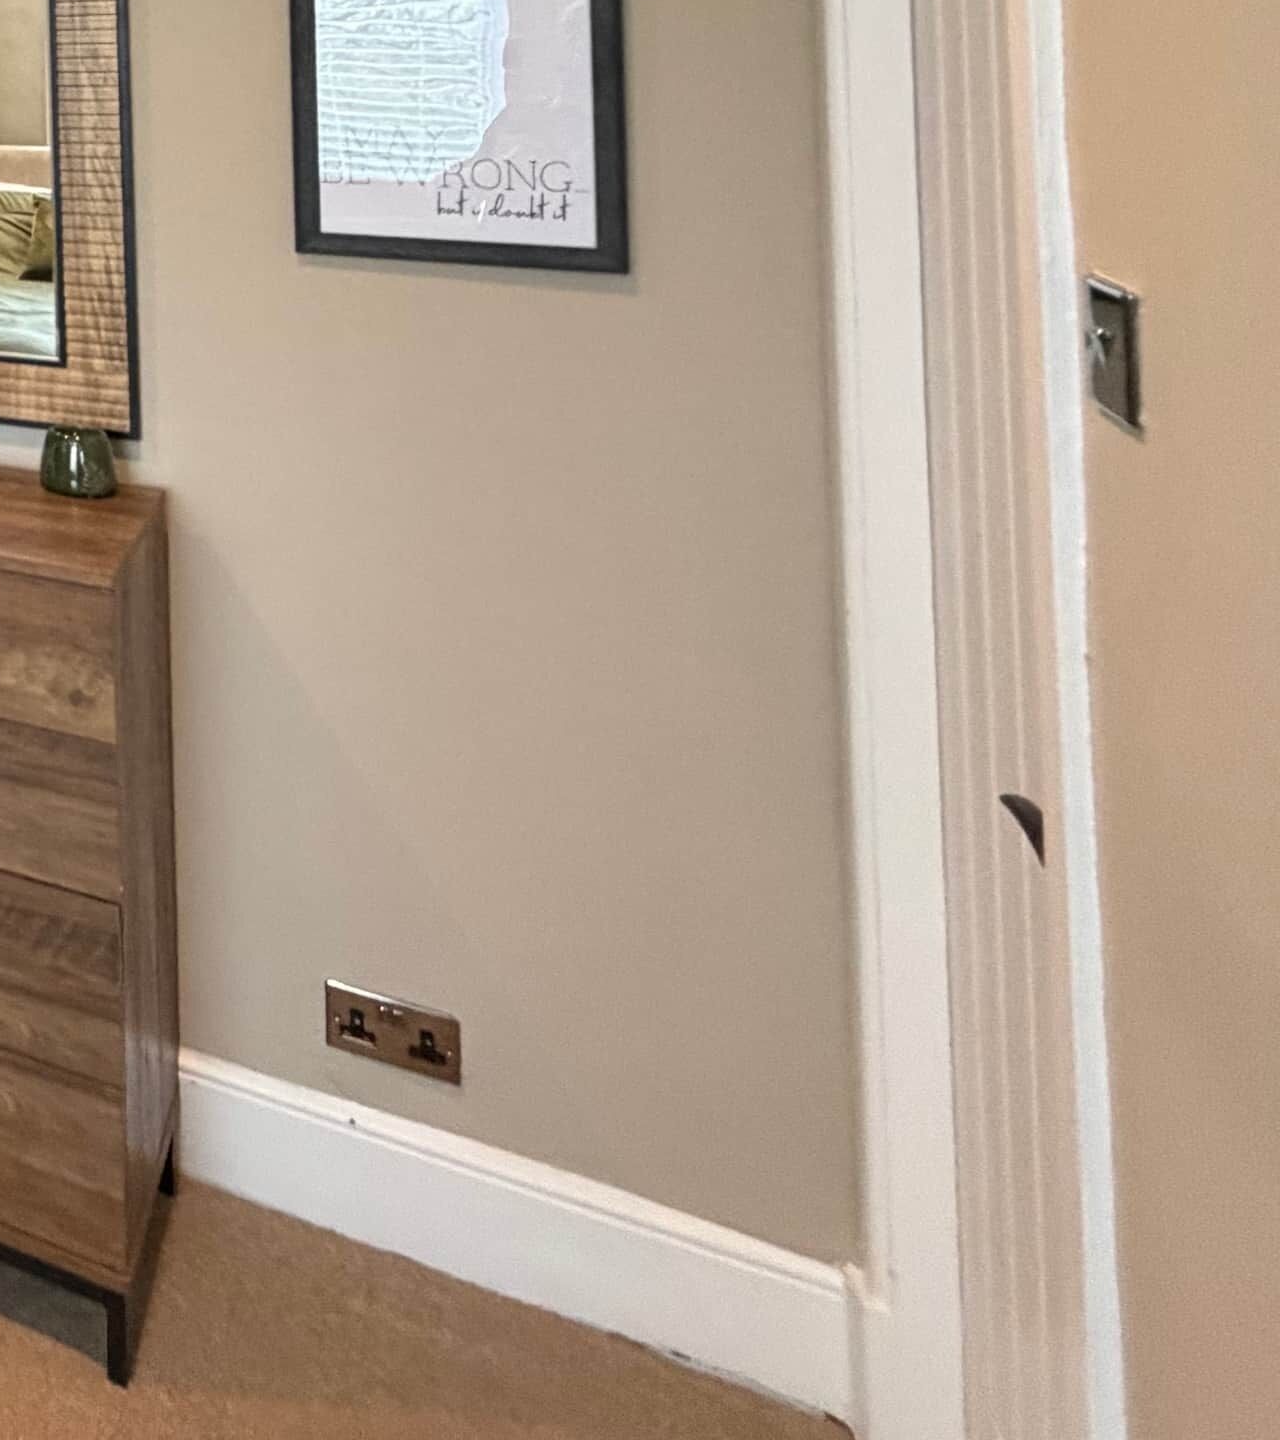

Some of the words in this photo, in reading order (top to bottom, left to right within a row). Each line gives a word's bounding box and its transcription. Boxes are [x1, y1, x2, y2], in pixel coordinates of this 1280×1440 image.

[436, 189, 467, 216] but
[488, 193, 549, 220] doubt
[552, 194, 573, 221] it
